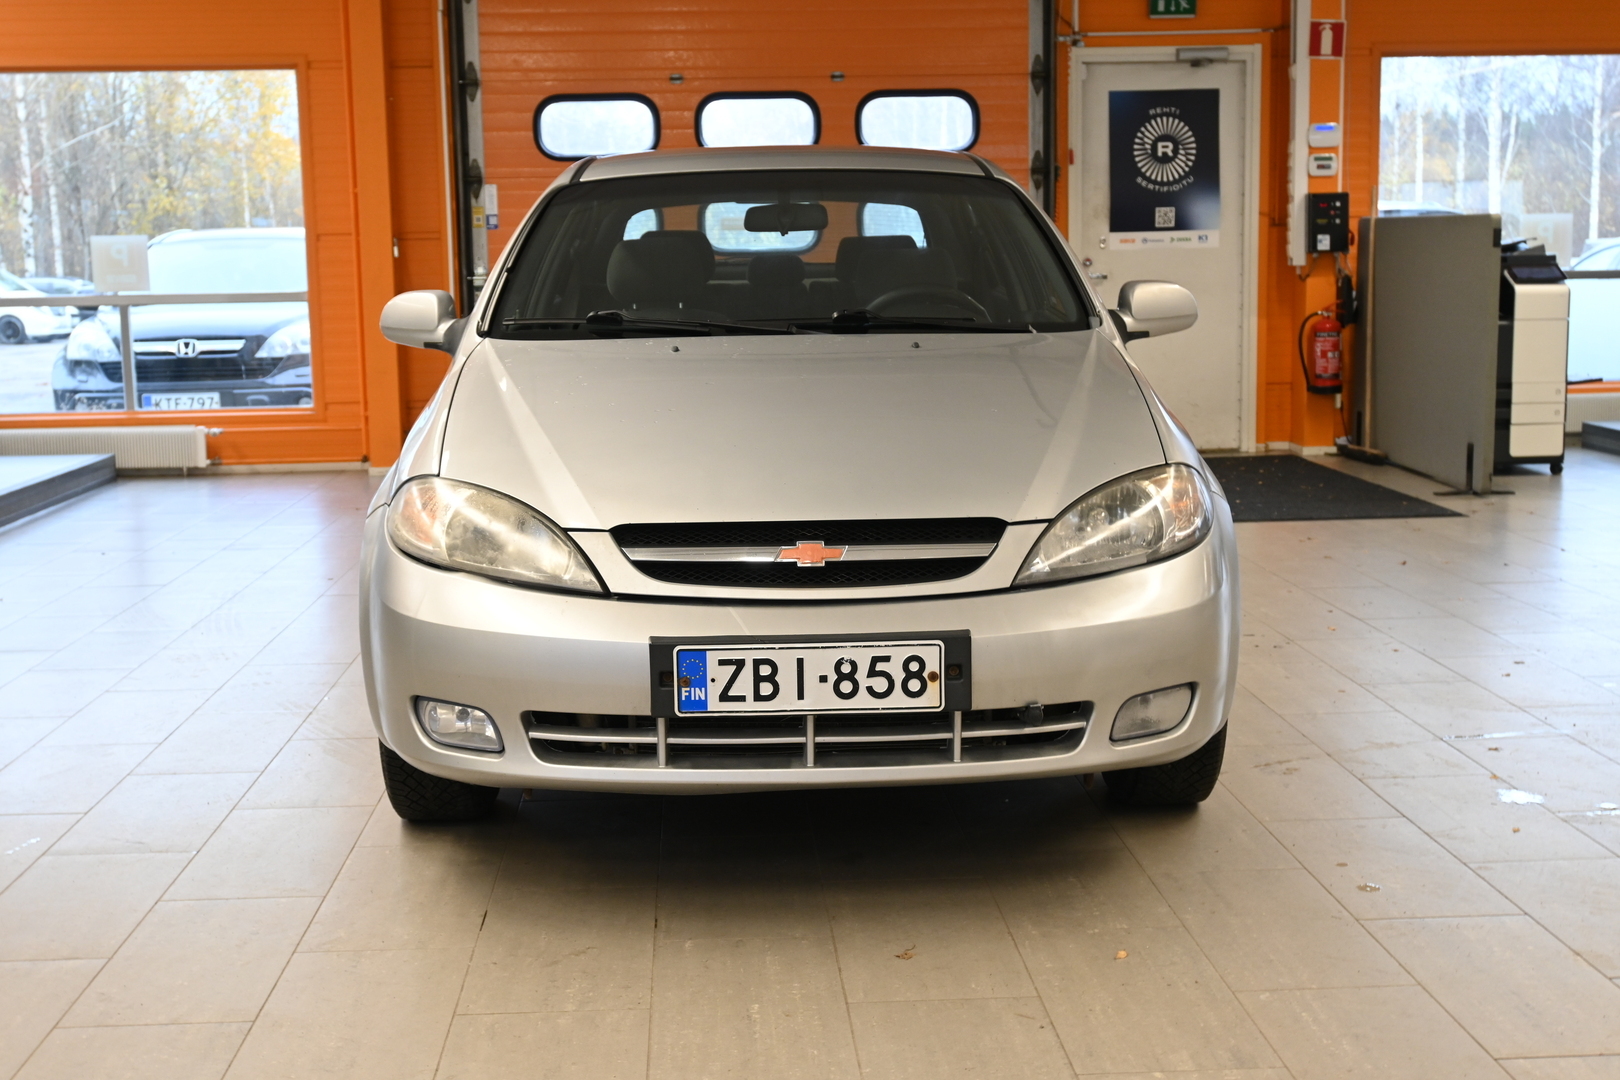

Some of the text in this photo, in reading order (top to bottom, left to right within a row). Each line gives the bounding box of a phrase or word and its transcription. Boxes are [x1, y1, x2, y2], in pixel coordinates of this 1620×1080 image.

[1149, 106, 1180, 115] REHTI
[1157, 141, 1174, 157] R
[717, 654, 927, 702] ZBI-858
[681, 687, 705, 701] FIN
